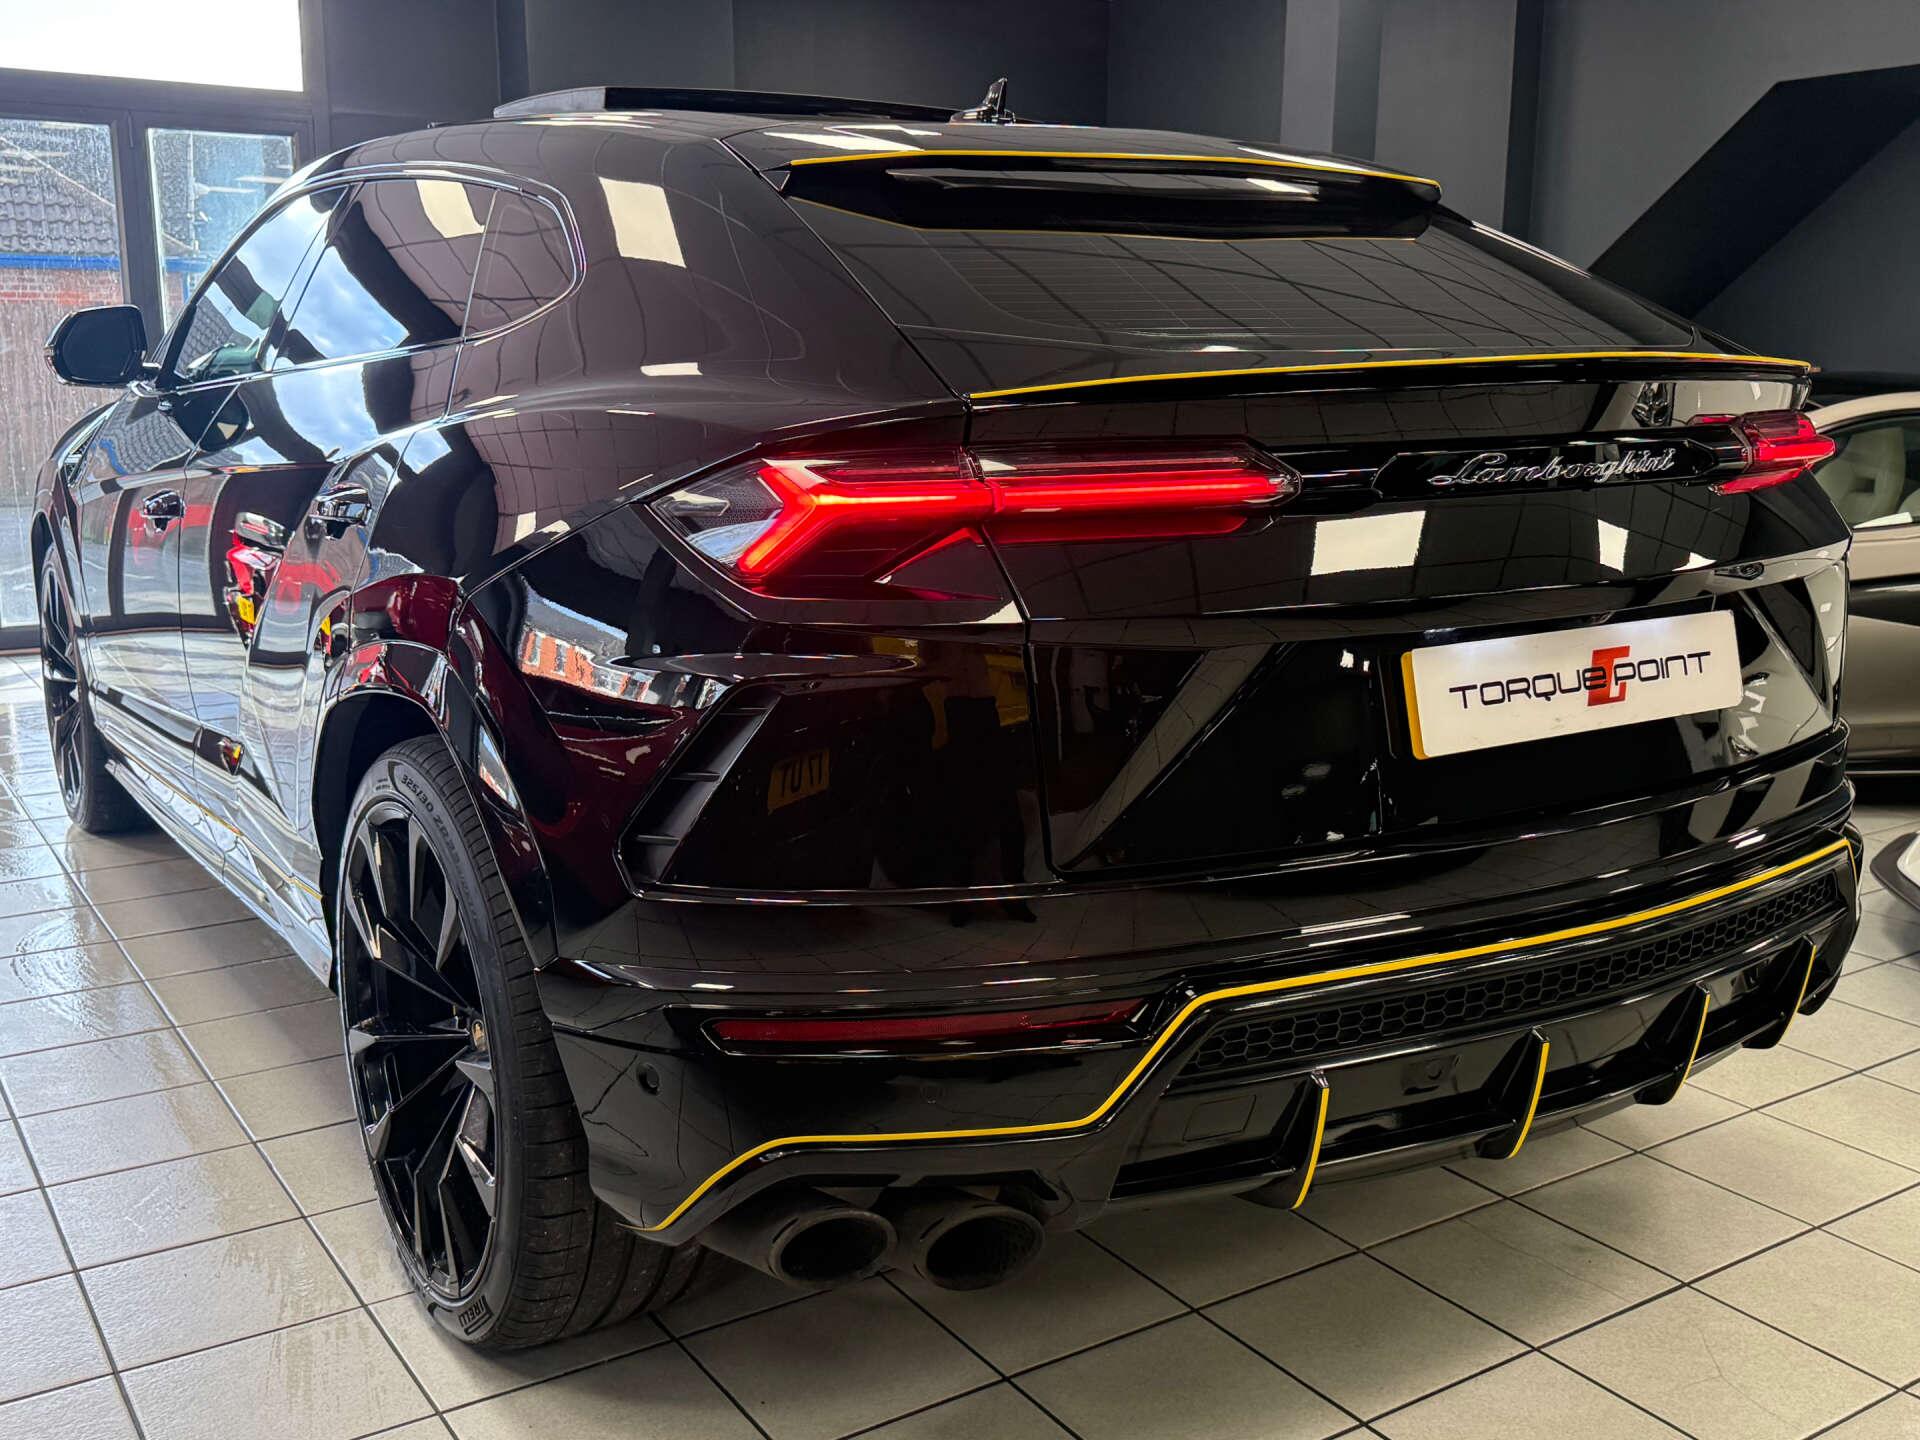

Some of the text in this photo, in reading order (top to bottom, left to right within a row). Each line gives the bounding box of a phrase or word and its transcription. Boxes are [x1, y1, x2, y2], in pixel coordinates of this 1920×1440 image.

[1427, 448, 1674, 484] Lamborghini
[1449, 651, 1711, 709] TORQUE POINT
[401, 774, 434, 812] 325/30
[458, 1295, 494, 1336] PIRELLI
